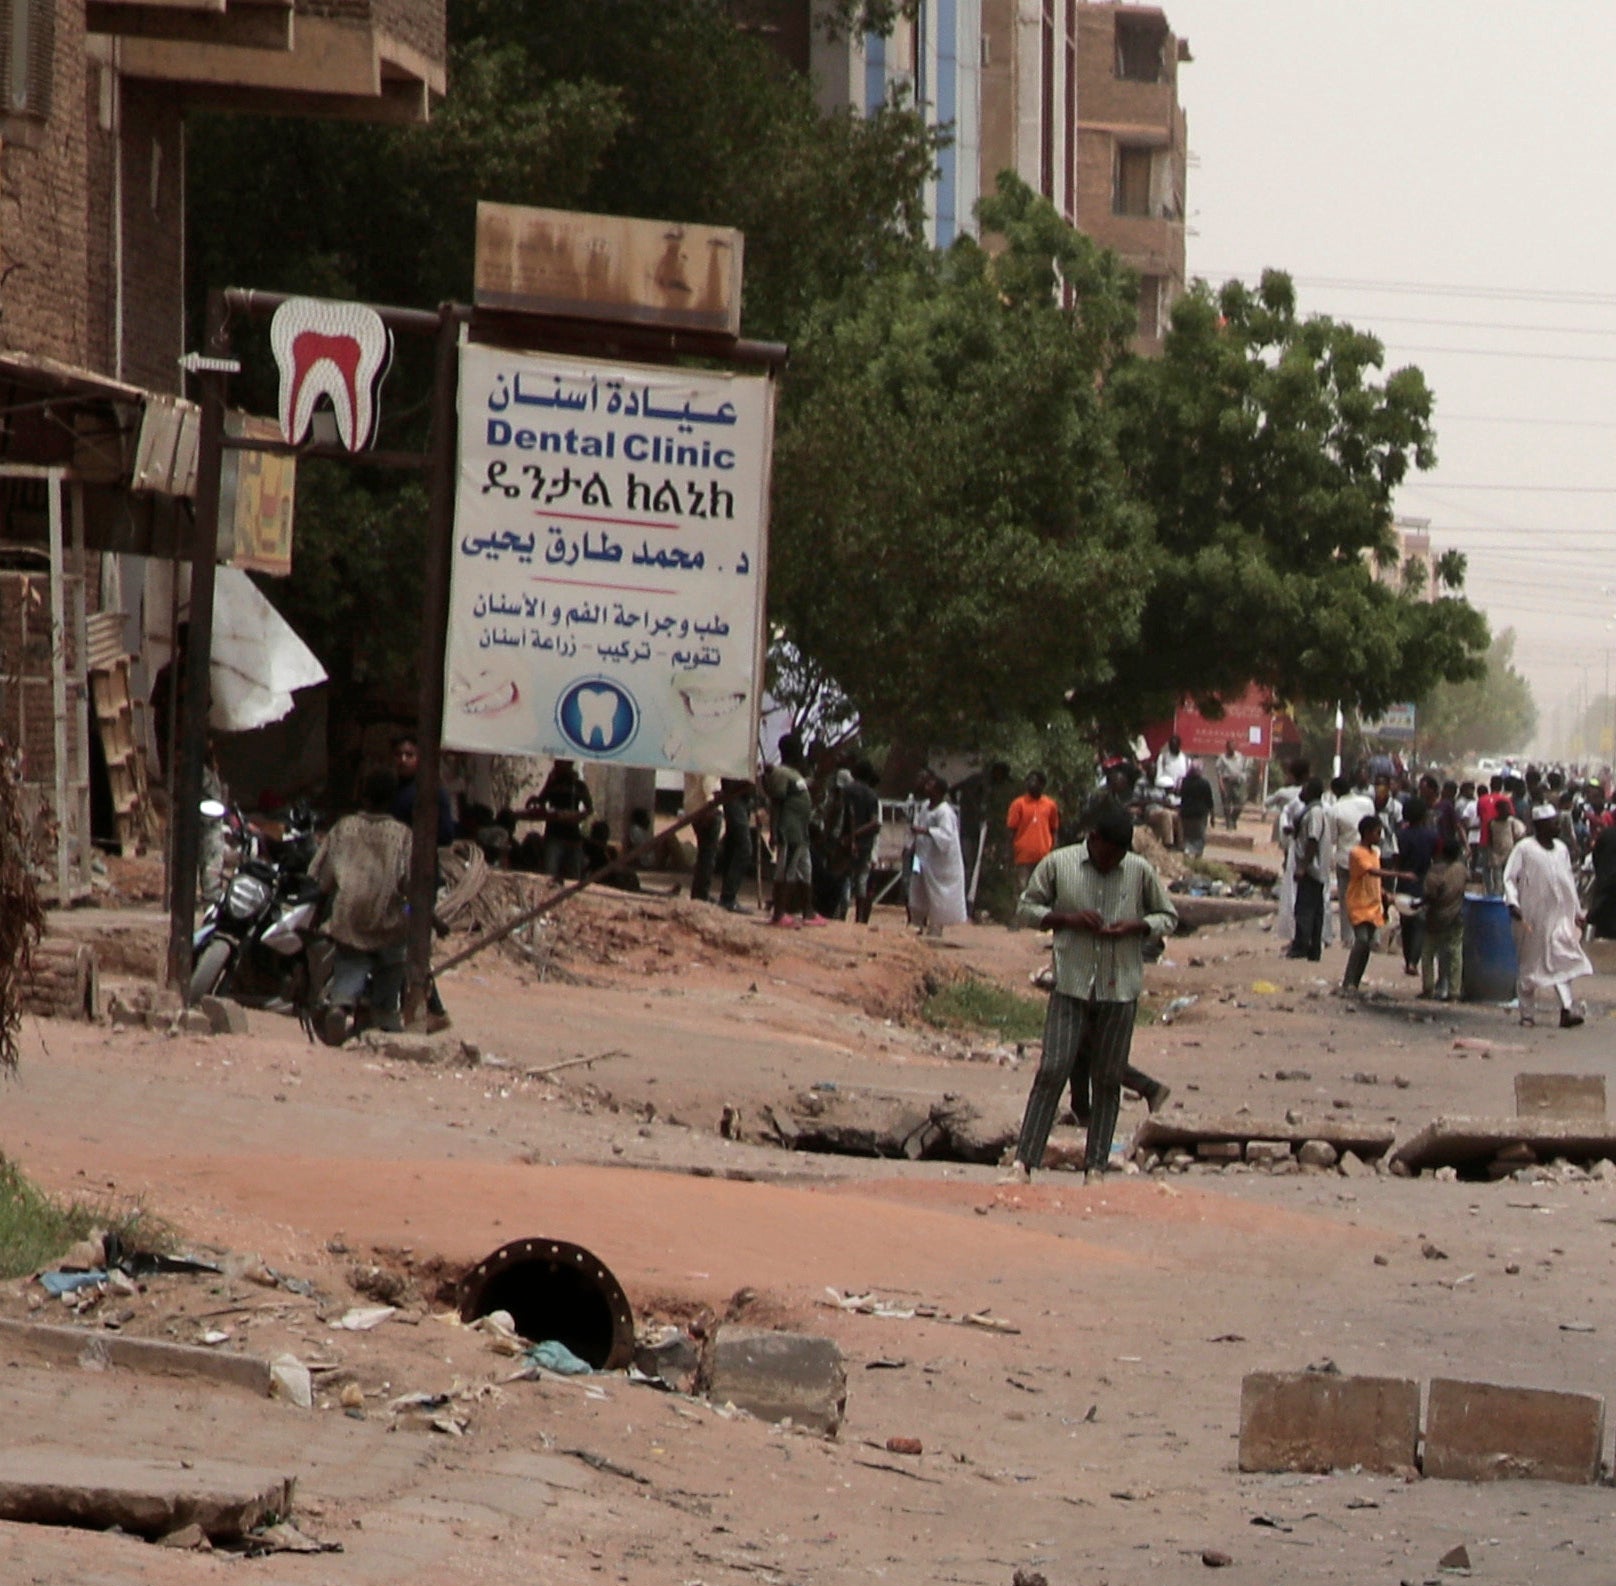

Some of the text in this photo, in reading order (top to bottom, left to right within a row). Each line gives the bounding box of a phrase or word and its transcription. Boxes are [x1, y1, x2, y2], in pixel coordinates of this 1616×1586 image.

[488, 372, 737, 433] عيادة أسنان
[487, 418, 736, 469] Dental Clinic
[461, 527, 535, 564] يحيى
[545, 527, 623, 565] طارق
[632, 540, 705, 570] محمد
[565, 601, 607, 628] الفم
[694, 615, 730, 641] طب
[479, 627, 721, 670] تقويم تركيب زراعة أسنان
